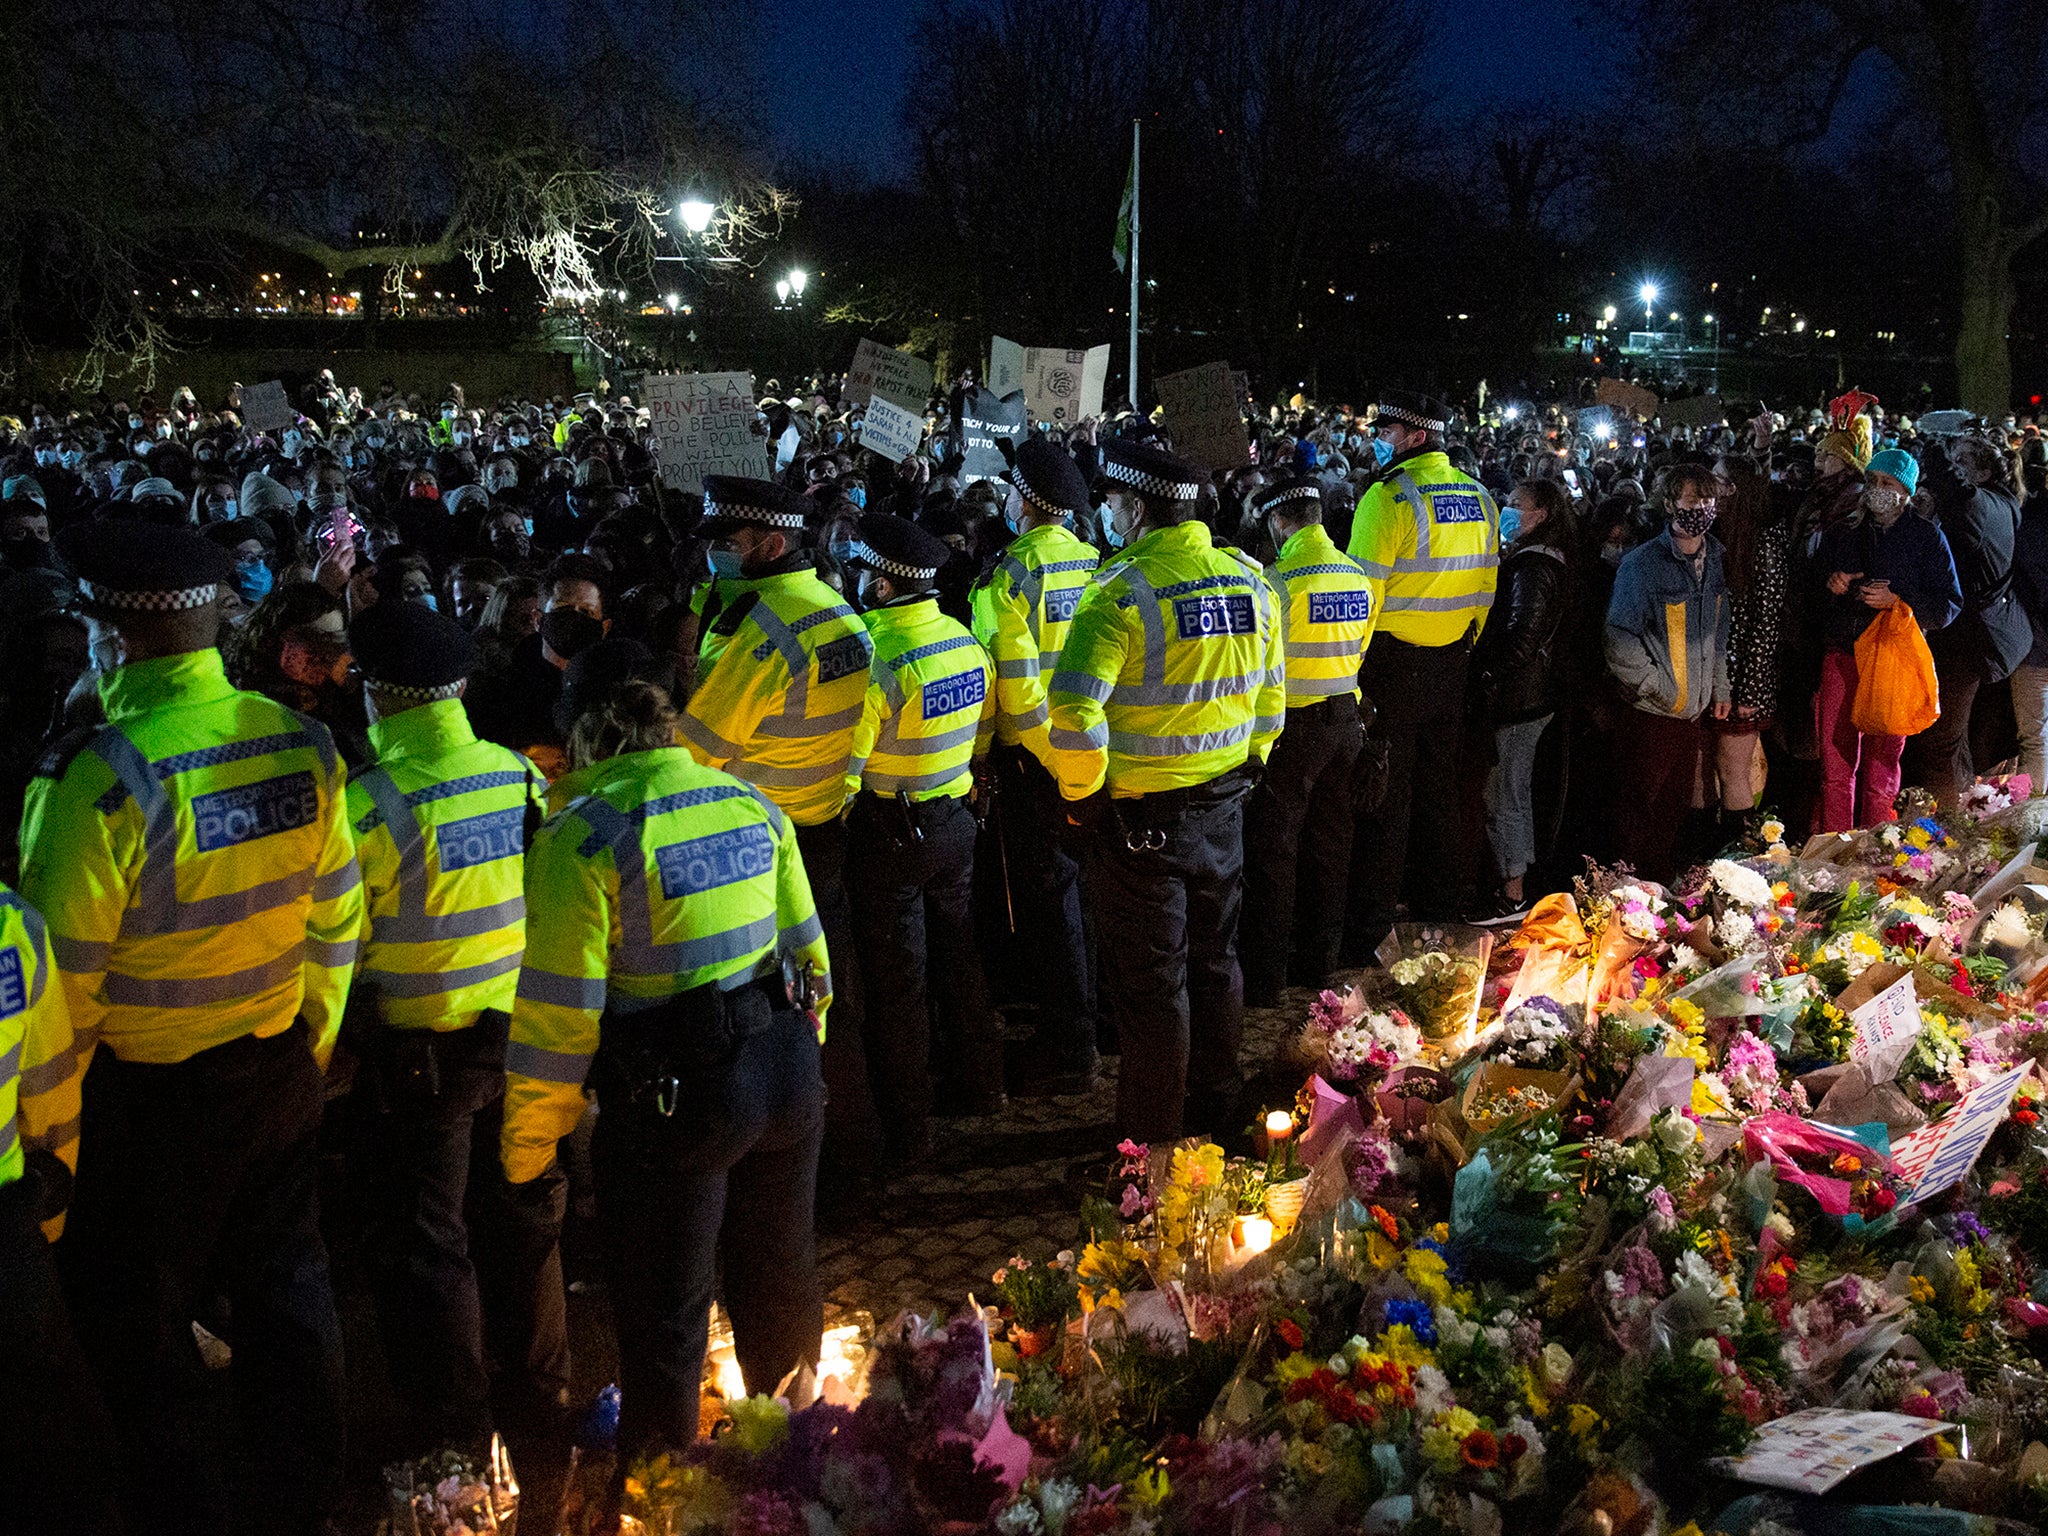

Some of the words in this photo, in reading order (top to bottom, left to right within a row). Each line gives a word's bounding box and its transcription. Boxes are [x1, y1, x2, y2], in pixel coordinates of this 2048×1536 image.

[648, 383, 676, 399] IT
[687, 379, 713, 398] IS
[725, 379, 741, 396] A
[652, 396, 754, 420] PRIVILEGE
[870, 399, 903, 424] JUSTICE
[906, 420, 913, 429] 4
[655, 419, 681, 434] TO
[691, 412, 757, 432] BELIEVE
[867, 413, 894, 431] SARAH
[903, 431, 918, 445] ALL
[984, 422, 1010, 434] YOUR
[659, 435, 697, 449] THE
[709, 430, 764, 448] POLICE
[864, 426, 893, 448] VICTIMS
[686, 449, 733, 461] WILL
[662, 459, 724, 484] PROTECT
[729, 457, 765, 479] YOU
[1436, 505, 1484, 521] POLICE
[1312, 593, 1367, 604] METROPOLITAN
[1312, 602, 1367, 621] POLICE
[925, 669, 982, 697] METROPOLITAN
[926, 681, 984, 716] POLICE
[199, 790, 318, 849] POLICE
[441, 825, 524, 870] POLIC
[658, 824, 768, 864] METROPOLITAN
[663, 842, 774, 895] POLICE
[1891, 993, 1905, 1016] END
[1953, 1072, 2022, 1132] OUR
[1908, 1117, 1996, 1203] VOICES
[1803, 1456, 1850, 1478] ALL
